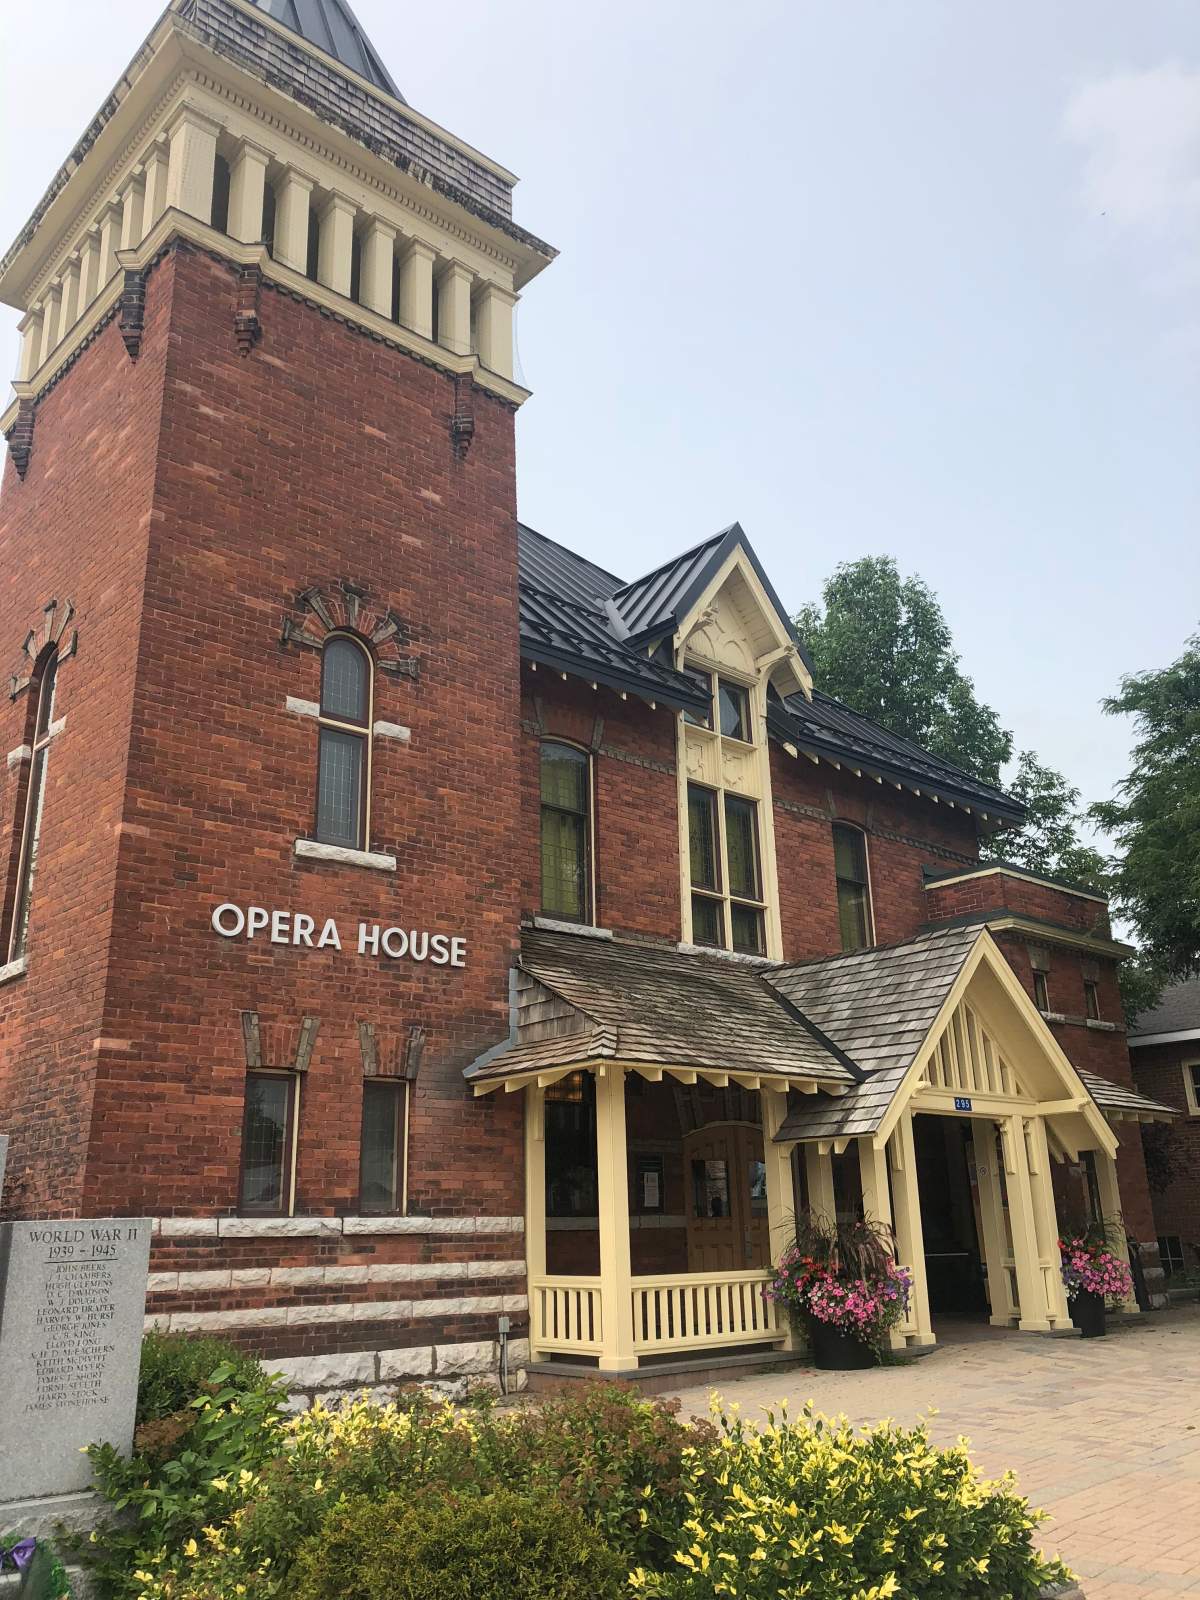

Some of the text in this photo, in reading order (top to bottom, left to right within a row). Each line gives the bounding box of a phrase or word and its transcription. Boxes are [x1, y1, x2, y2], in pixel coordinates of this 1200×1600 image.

[211, 903, 467, 967] OPERA HOUSE
[955, 1099, 970, 1108] 295
[29, 1228, 138, 1243] WORLD WAR II
[48, 1246, 74, 1259] 1939
[91, 1244, 117, 1257] 1945
[64, 1271, 112, 1281] CHAMBERS
[45, 1280, 113, 1291] HUGH CLEMENS
[68, 1288, 110, 1297] DAVIDSON
[69, 1296, 108, 1306] DOUGLAS
[37, 1304, 115, 1315] LEONARD DRAPER
[36, 1315, 71, 1325] HARVEY
[88, 1312, 114, 1321] HURST
[43, 1321, 106, 1332] GEORGE JONES
[36, 1365, 74, 1375] EDWARD
